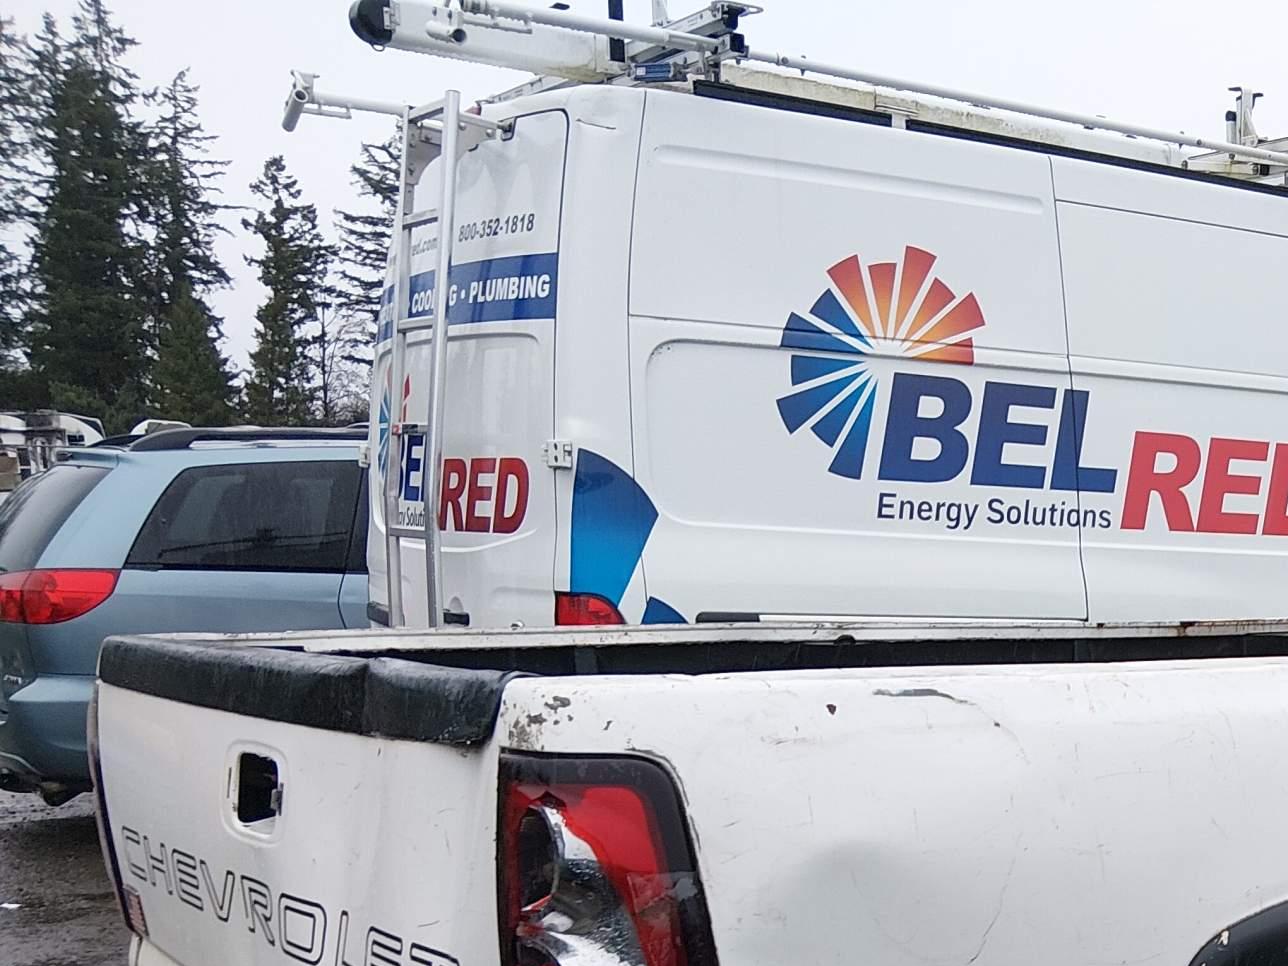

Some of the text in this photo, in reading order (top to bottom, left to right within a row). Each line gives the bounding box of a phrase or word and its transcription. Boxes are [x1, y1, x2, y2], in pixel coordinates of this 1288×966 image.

[458, 213, 535, 243] 800-352-1818
[469, 274, 550, 304] PLUMBING
[439, 457, 529, 534] RED
[877, 491, 1113, 530] Energy Solutions
